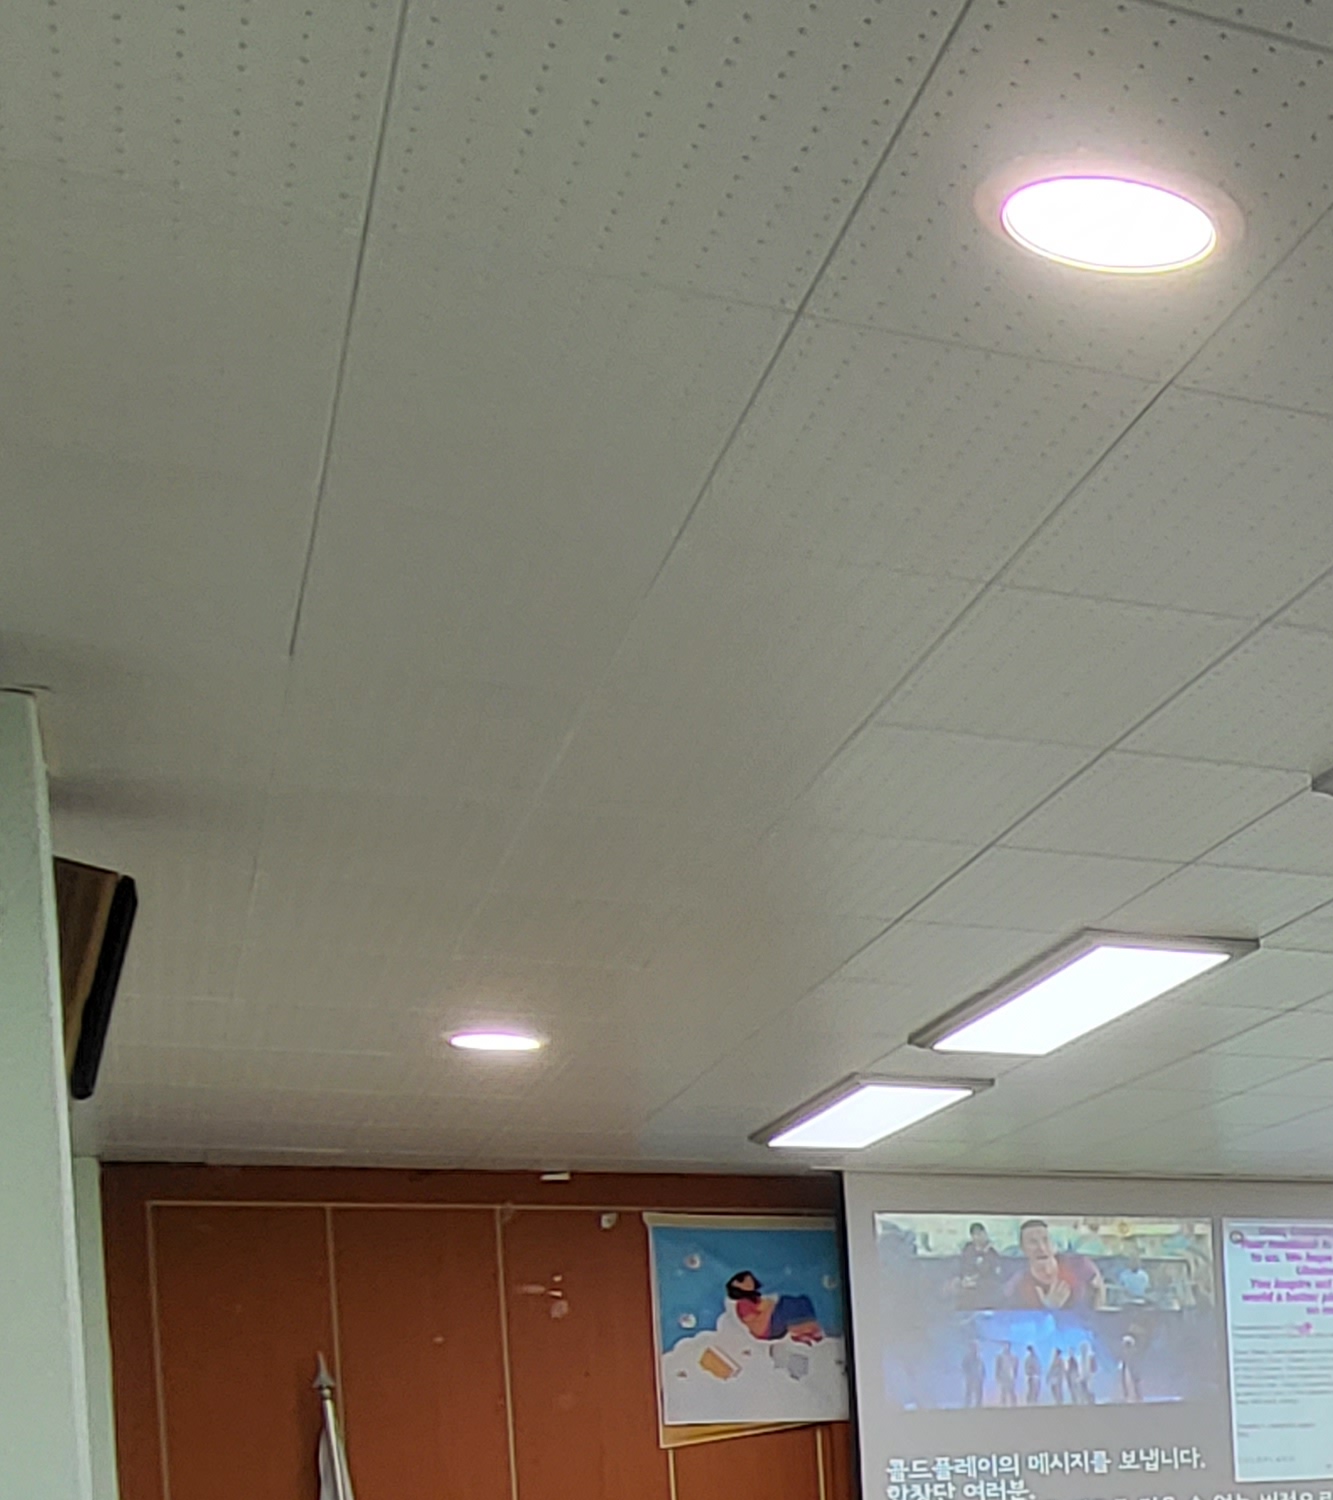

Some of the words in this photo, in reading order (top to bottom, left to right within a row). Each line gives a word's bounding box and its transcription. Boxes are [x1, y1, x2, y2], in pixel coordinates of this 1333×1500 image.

[886, 1453, 1020, 1482] 콜드플레이의
[1027, 1450, 1111, 1475] 메시지를
[1119, 1447, 1206, 1471] 보냅니다.
